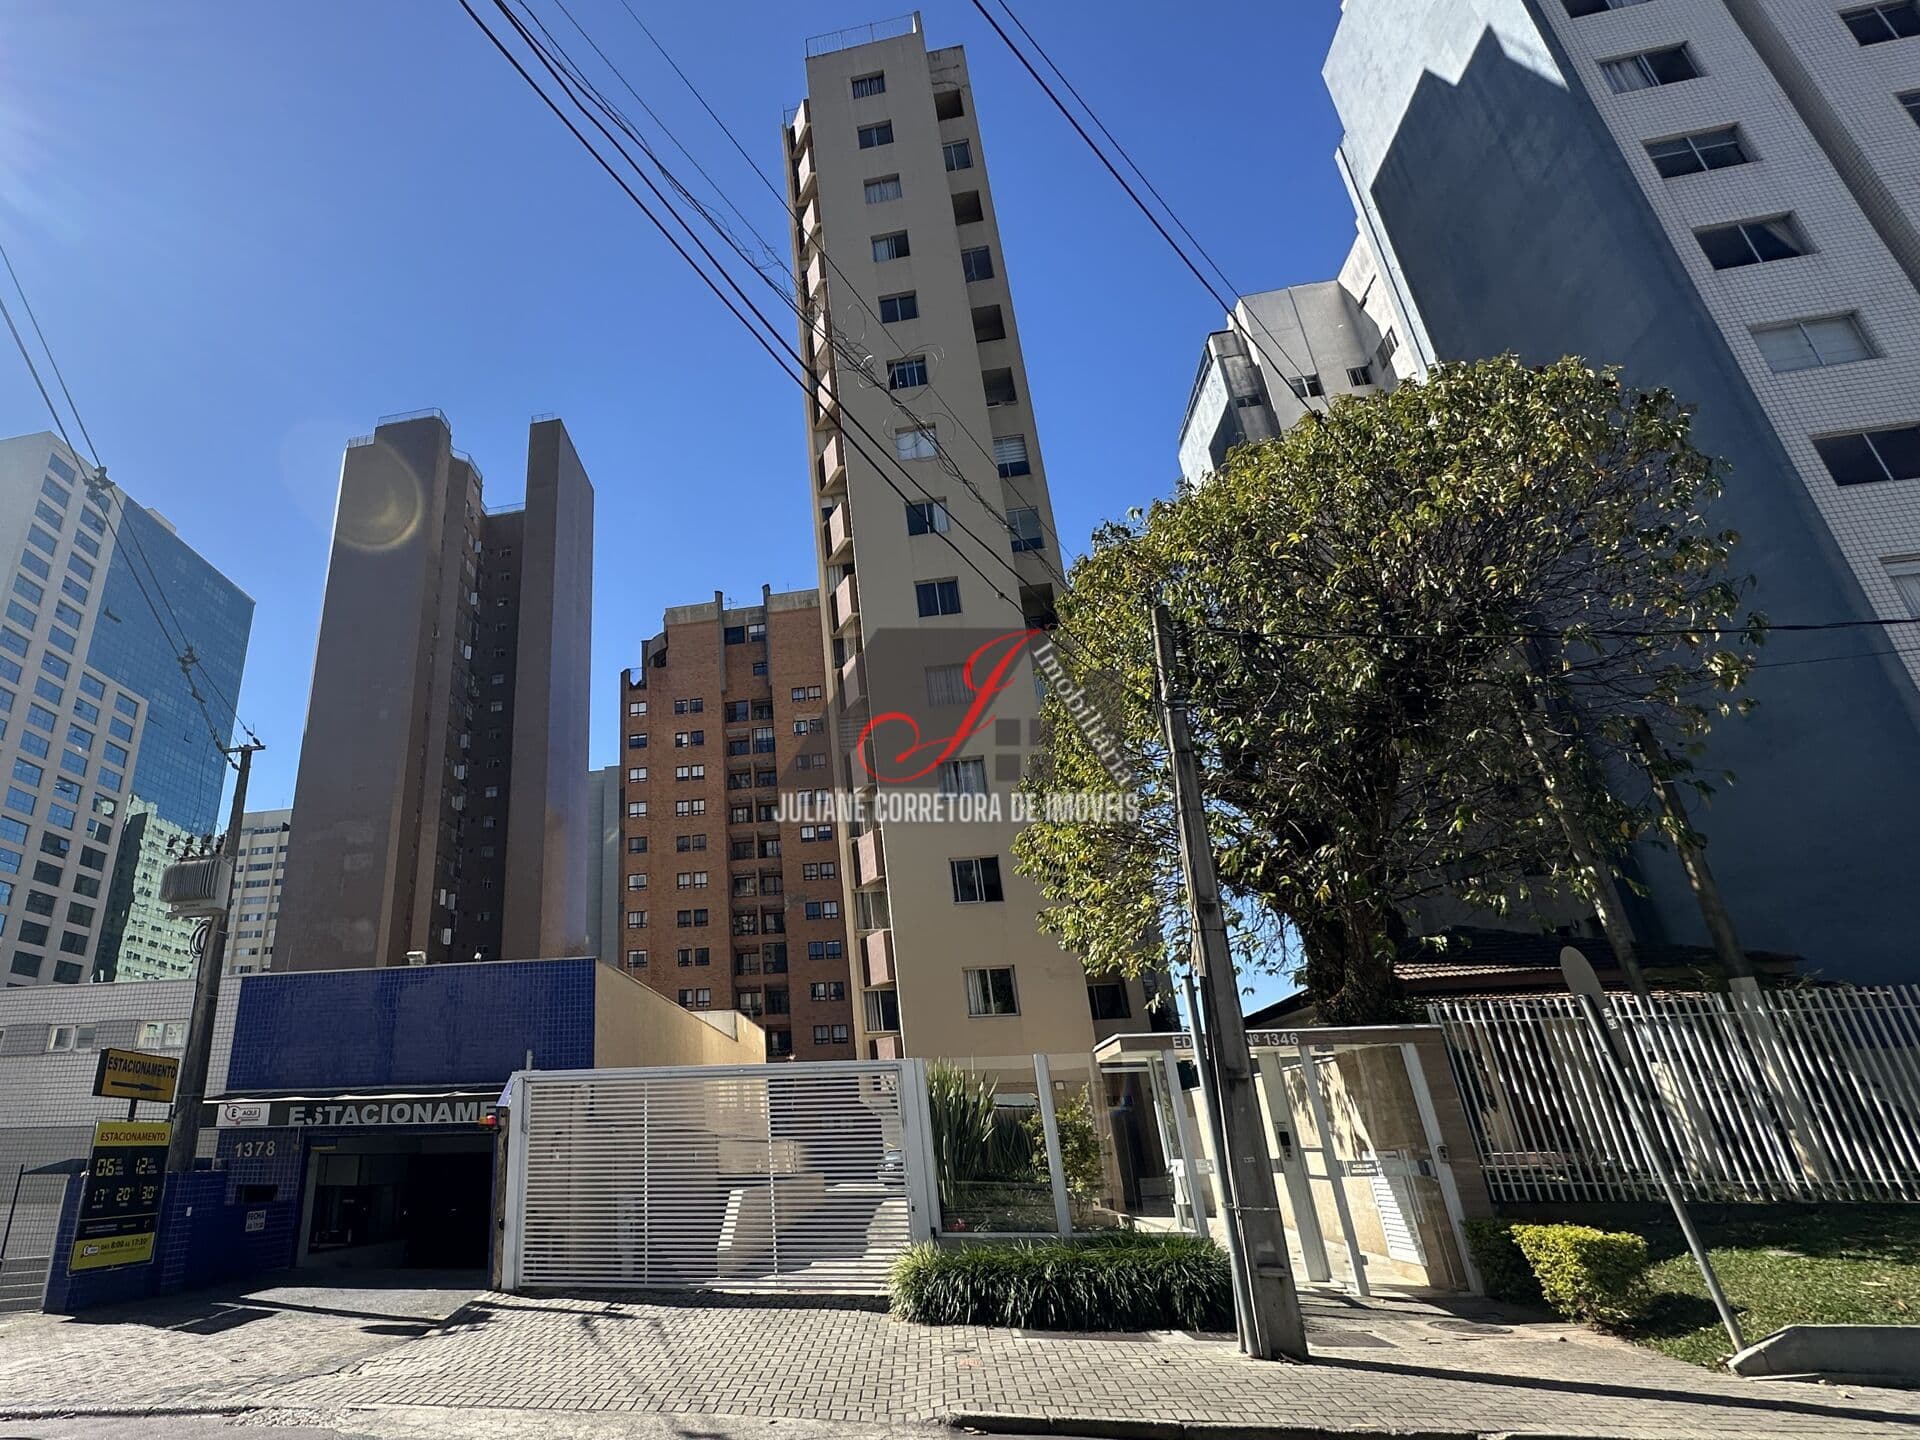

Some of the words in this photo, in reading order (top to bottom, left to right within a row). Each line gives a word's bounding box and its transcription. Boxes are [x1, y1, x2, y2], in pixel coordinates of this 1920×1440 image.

[1264, 1032, 1299, 1046] 1346
[107, 1056, 177, 1079] ESTACIONAMENTO
[241, 1109, 258, 1117] AQUI
[100, 1131, 166, 1142] ESTACIONAMENTO
[235, 1140, 276, 1158] 1378
